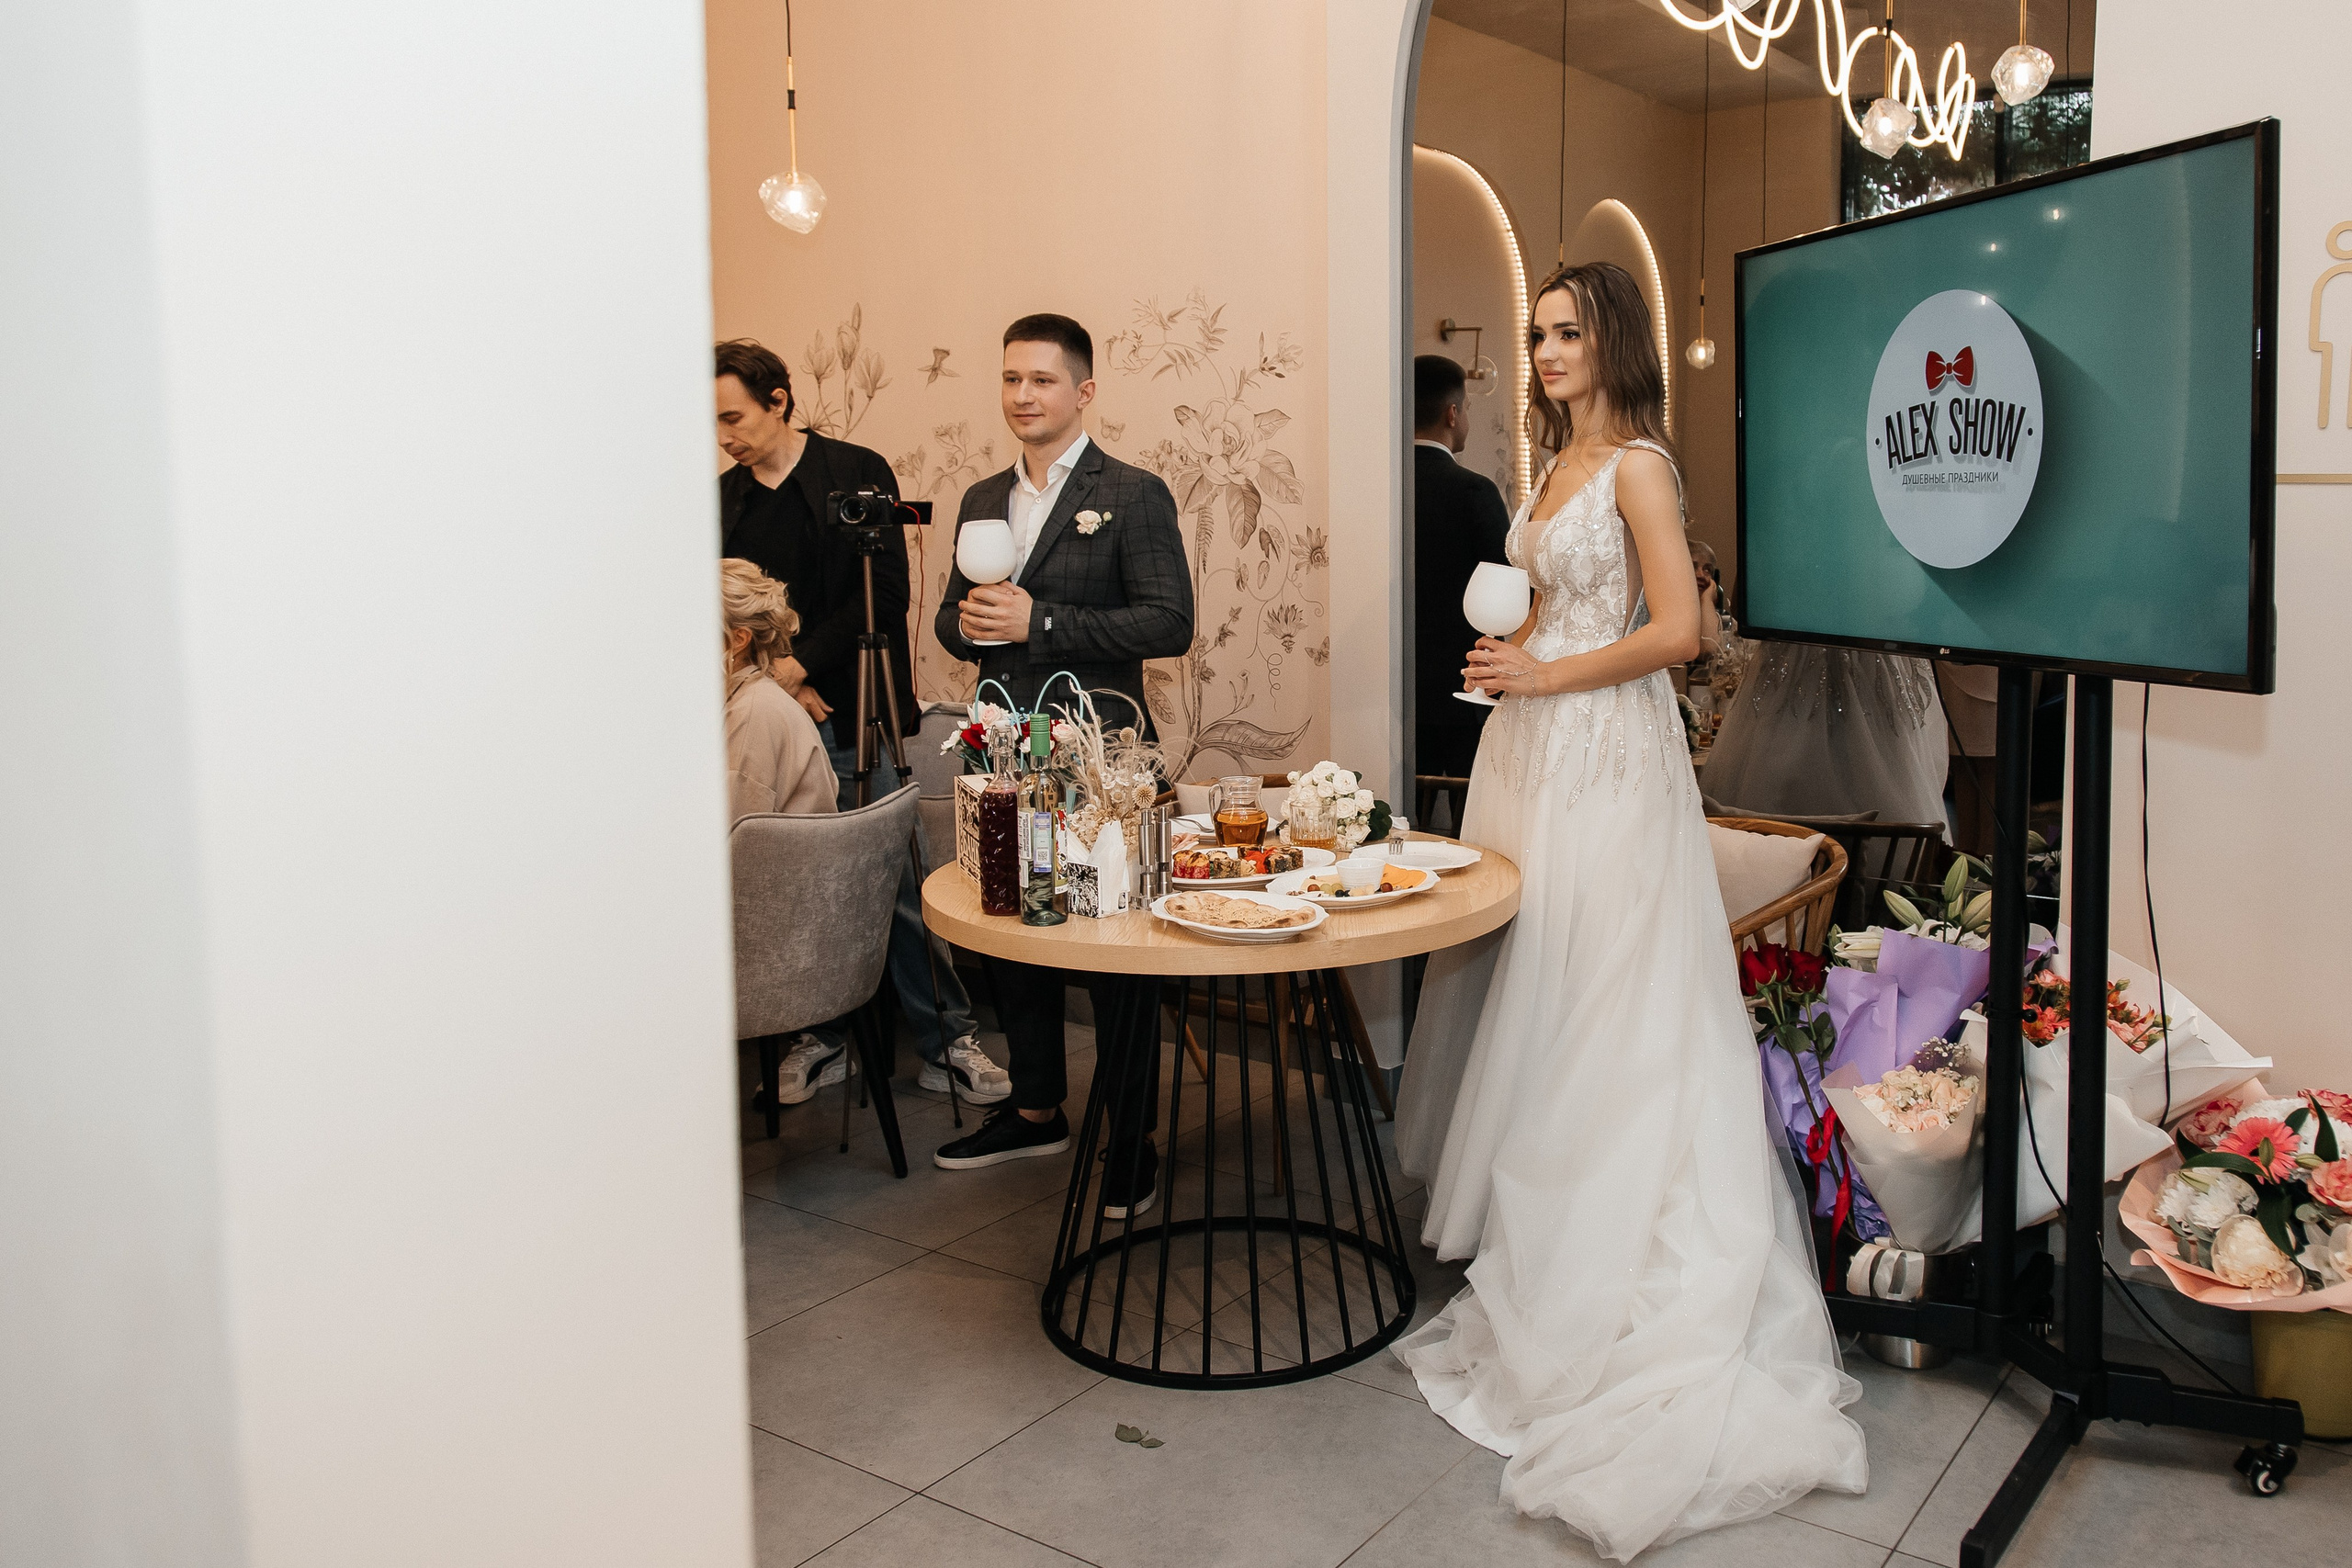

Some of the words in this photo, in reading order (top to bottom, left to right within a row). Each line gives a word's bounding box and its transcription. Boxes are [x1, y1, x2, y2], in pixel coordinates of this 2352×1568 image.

[1885, 400, 1939, 469] ALEX
[1949, 398, 2026, 463] SHOW
[1902, 473, 1945, 485] ДУШЕВНЫЕ
[1949, 471, 1999, 483] ПРАЗДНИКИ
